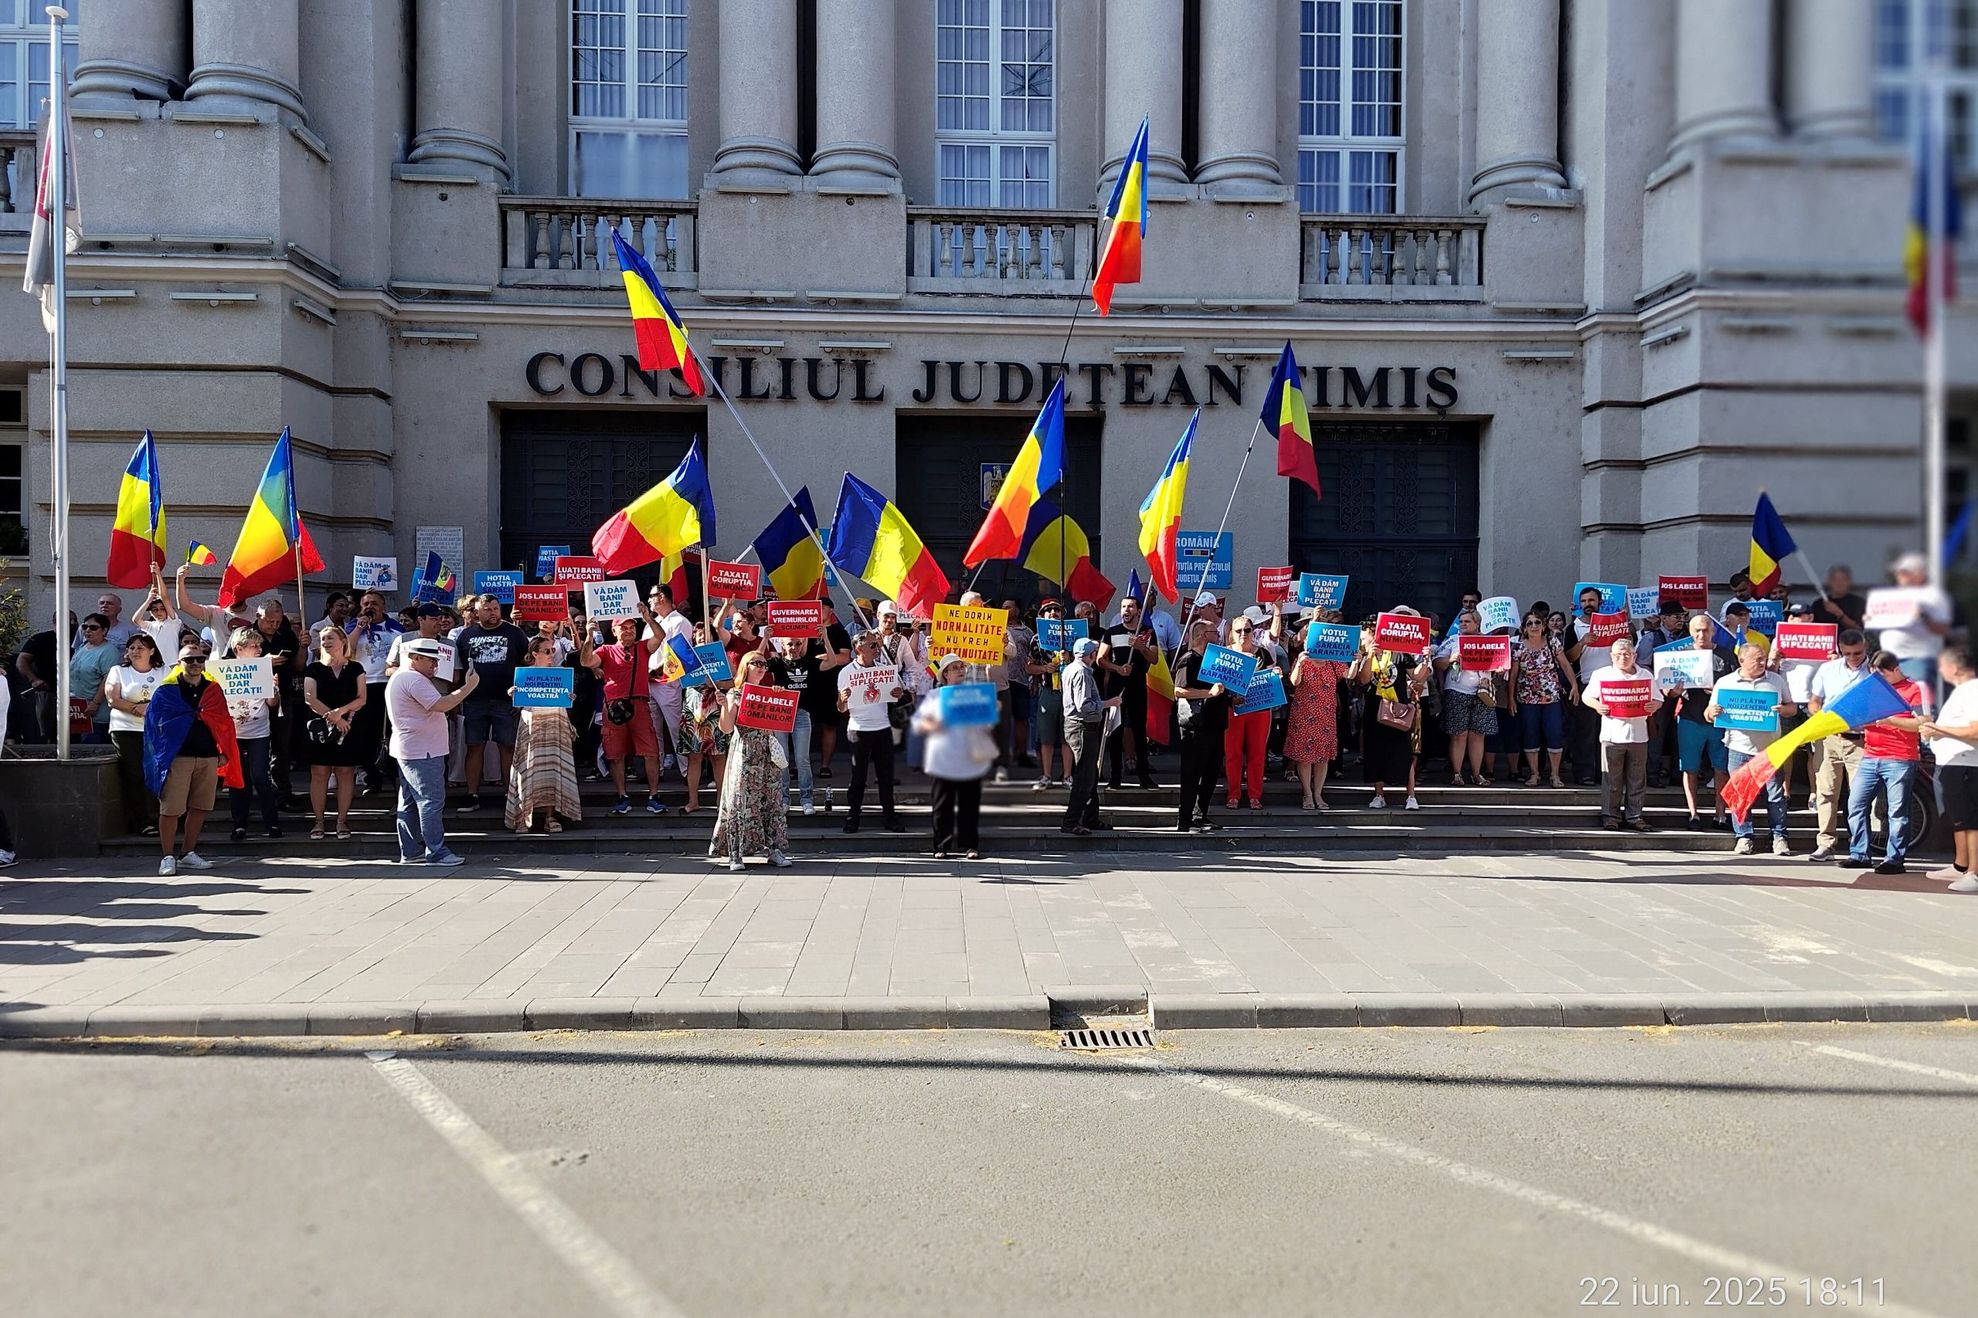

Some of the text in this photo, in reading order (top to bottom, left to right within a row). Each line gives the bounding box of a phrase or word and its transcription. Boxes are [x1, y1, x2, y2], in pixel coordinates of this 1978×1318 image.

[599, 594, 624, 602] BANII
[603, 601, 622, 609] DAR
[950, 609, 961, 618] NE
[936, 620, 1002, 636] NORMALITATE
[1322, 628, 1349, 637] VOTUL
[946, 635, 958, 644] NU
[1219, 651, 1244, 666] VOTUL
[229, 680, 250, 688] DAR
[224, 687, 262, 696] LECAȚI!
[745, 693, 795, 707] JOS LABELE
